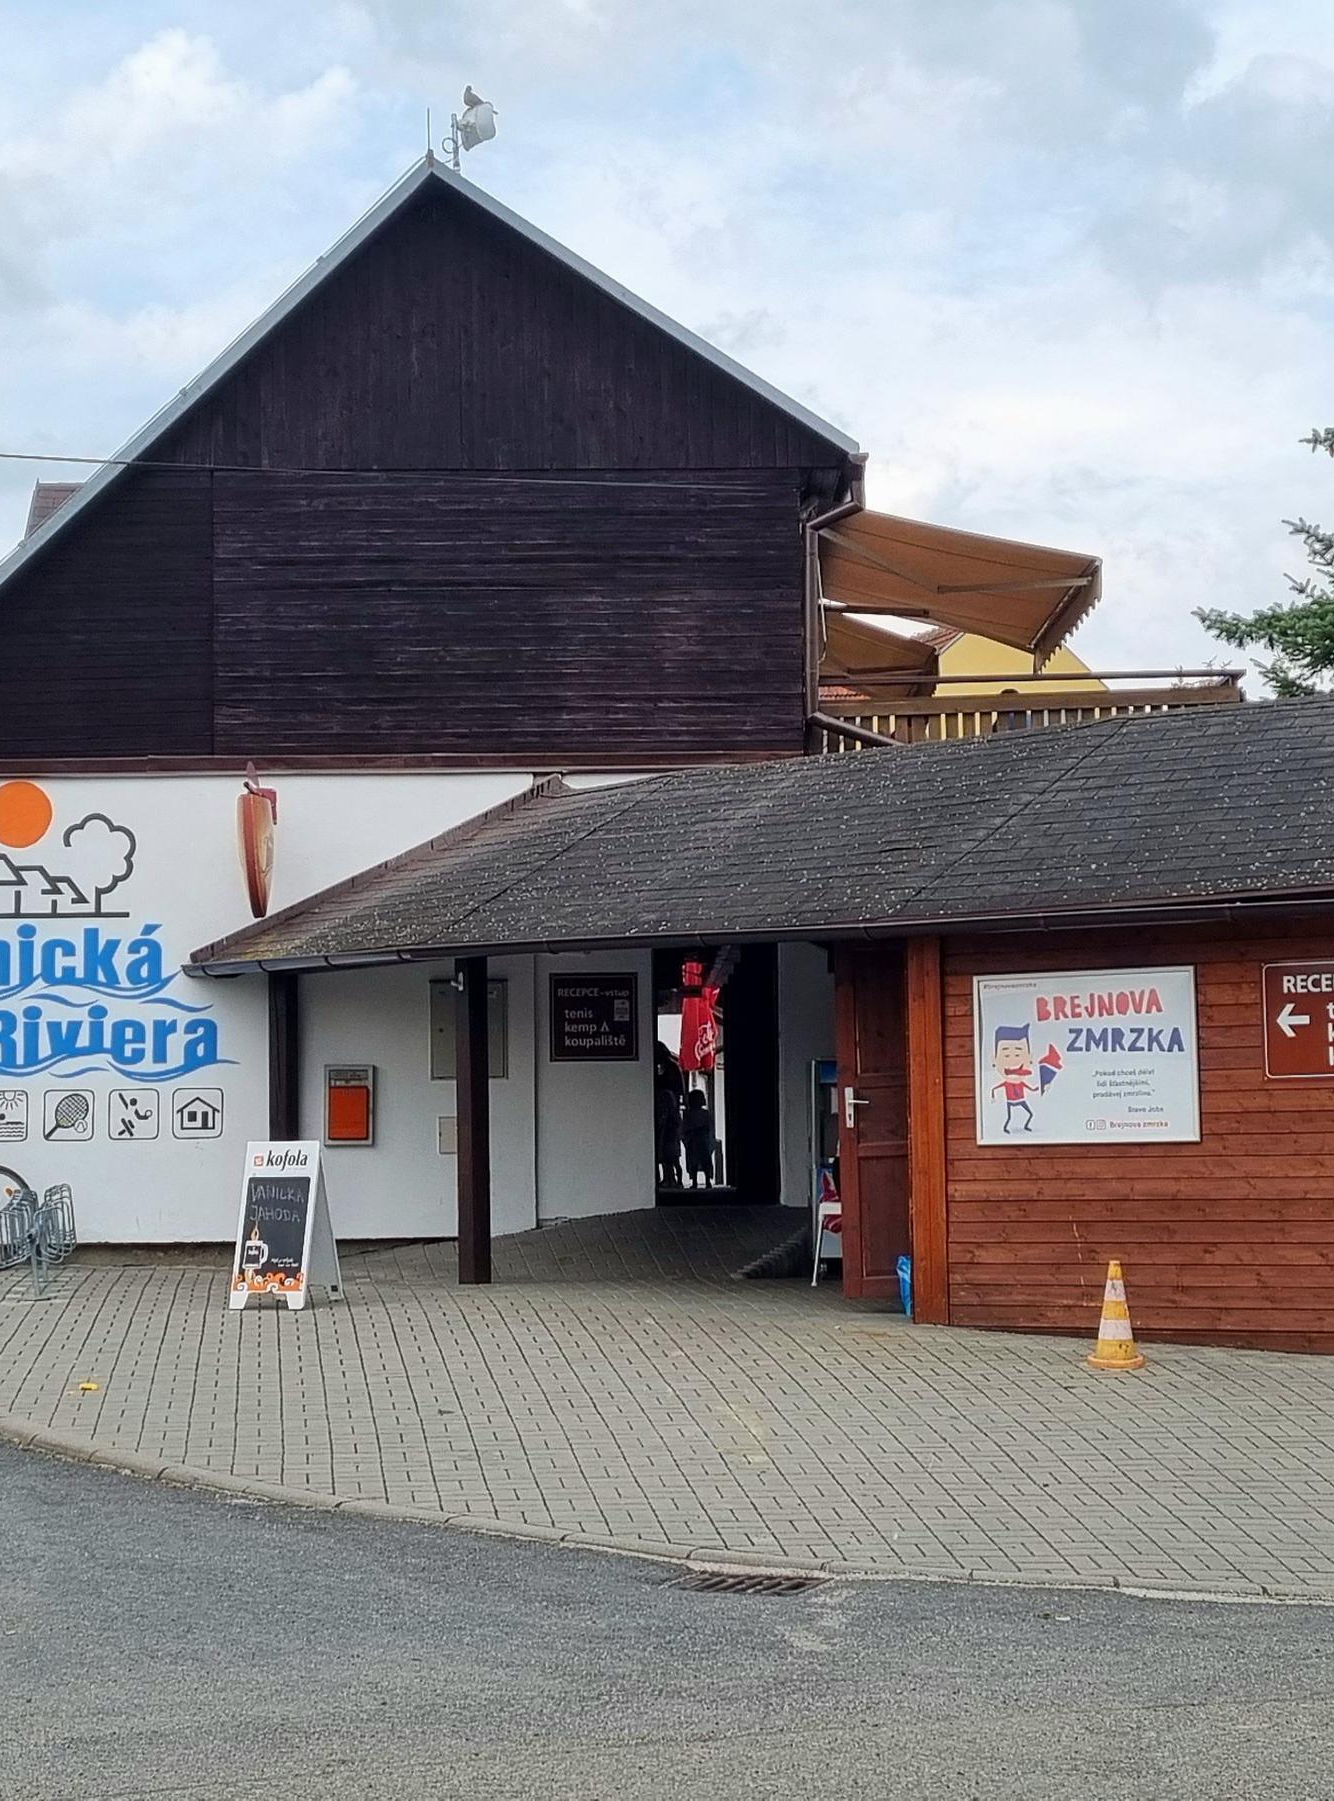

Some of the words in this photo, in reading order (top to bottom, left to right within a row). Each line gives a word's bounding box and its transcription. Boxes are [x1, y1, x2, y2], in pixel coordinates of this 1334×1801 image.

[564, 1007, 594, 1019] tenis
[1035, 987, 1164, 1022] BREJNOVA
[564, 1021, 598, 1035] kemp
[564, 1034, 627, 1049] koupaliště
[1066, 1026, 1185, 1052] ZMRZKA
[265, 1149, 309, 1172] kofola
[249, 1204, 301, 1223] JAHODA
